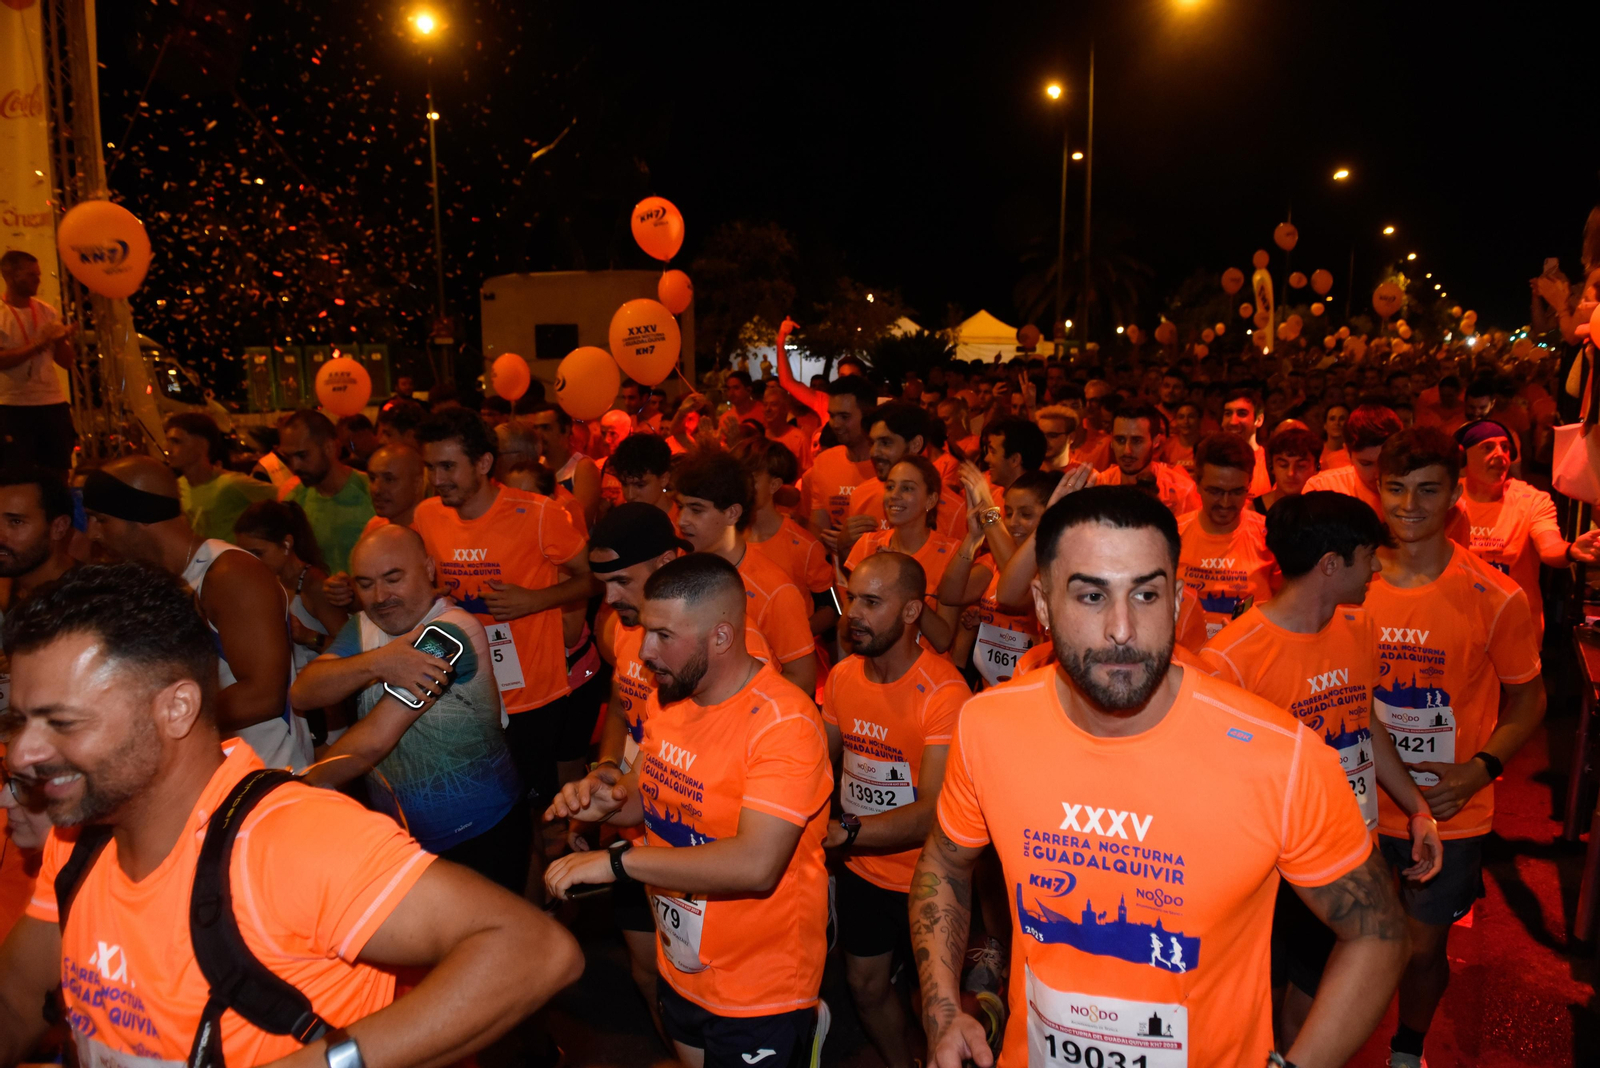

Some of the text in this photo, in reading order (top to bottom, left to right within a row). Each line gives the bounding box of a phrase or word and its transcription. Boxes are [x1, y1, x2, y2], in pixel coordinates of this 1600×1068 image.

[628, 324, 657, 336] XXXV
[453, 549, 488, 561] XXXV
[1200, 558, 1235, 568] XXXV
[1380, 627, 1429, 645] XXXV
[988, 648, 1017, 668] 1661
[1401, 645, 1446, 656] NOCTURNA
[1307, 668, 1348, 694] XXXV
[1291, 685, 1366, 710] CARRERA NOCTURNA
[853, 718, 888, 741] XXXV
[659, 740, 697, 771] XXXV
[645, 765, 703, 803] GUADALQUIVIR
[646, 753, 704, 791] CARRERA NOCTURNA
[849, 782, 897, 806] 13932
[1059, 802, 1153, 842] XXXV
[1024, 829, 1185, 867] CARRERA NOCTURNA
[1032, 846, 1184, 885] GUADALQUIVIR
[1025, 926, 1044, 942] 2023
[1060, 1026, 1092, 1038] NOCTURNA
[1104, 1036, 1149, 1046] GUADALQUIVIR
[1044, 1034, 1148, 1068] 19031
